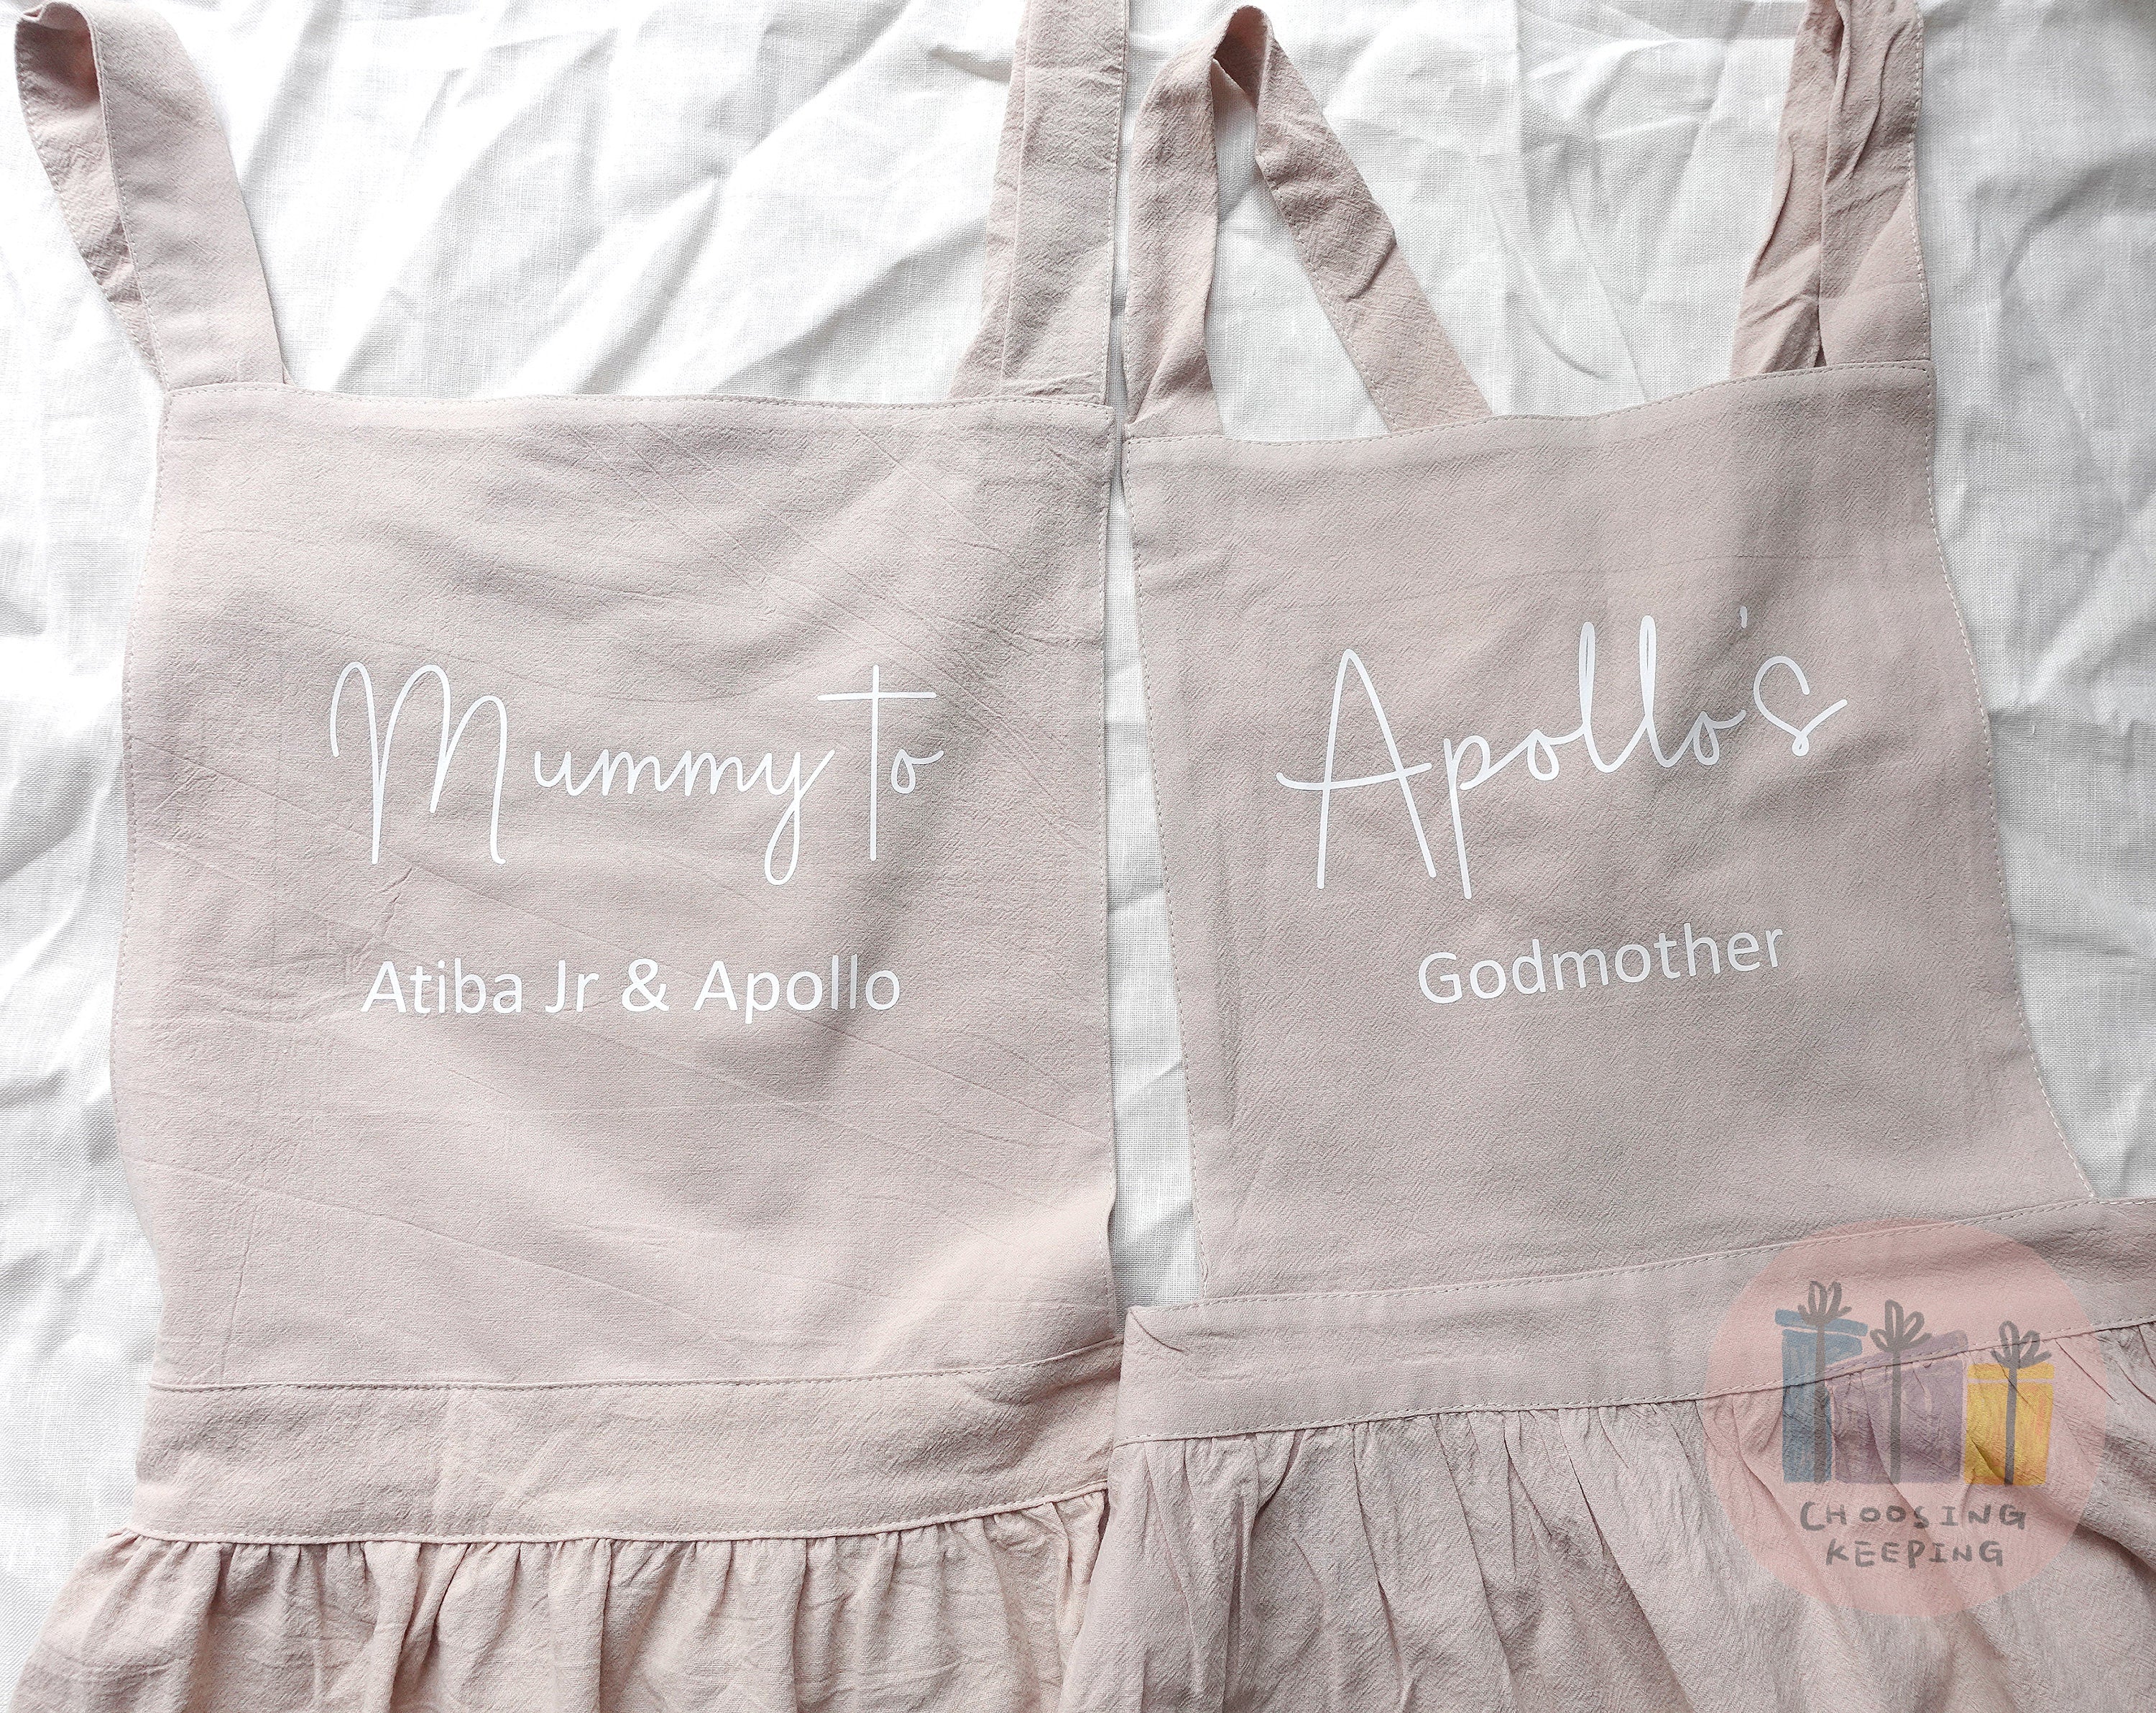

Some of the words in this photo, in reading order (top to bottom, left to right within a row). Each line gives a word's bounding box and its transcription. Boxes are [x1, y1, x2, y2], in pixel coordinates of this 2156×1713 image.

[331, 661, 835, 886] Mummy
[1276, 606, 1848, 899] Apollo's
[360, 957, 522, 1015] Atiba
[545, 959, 599, 1014] Jr
[621, 957, 670, 1013] &
[692, 953, 901, 1025] Apollo
[1419, 922, 1784, 1004] Godmother
